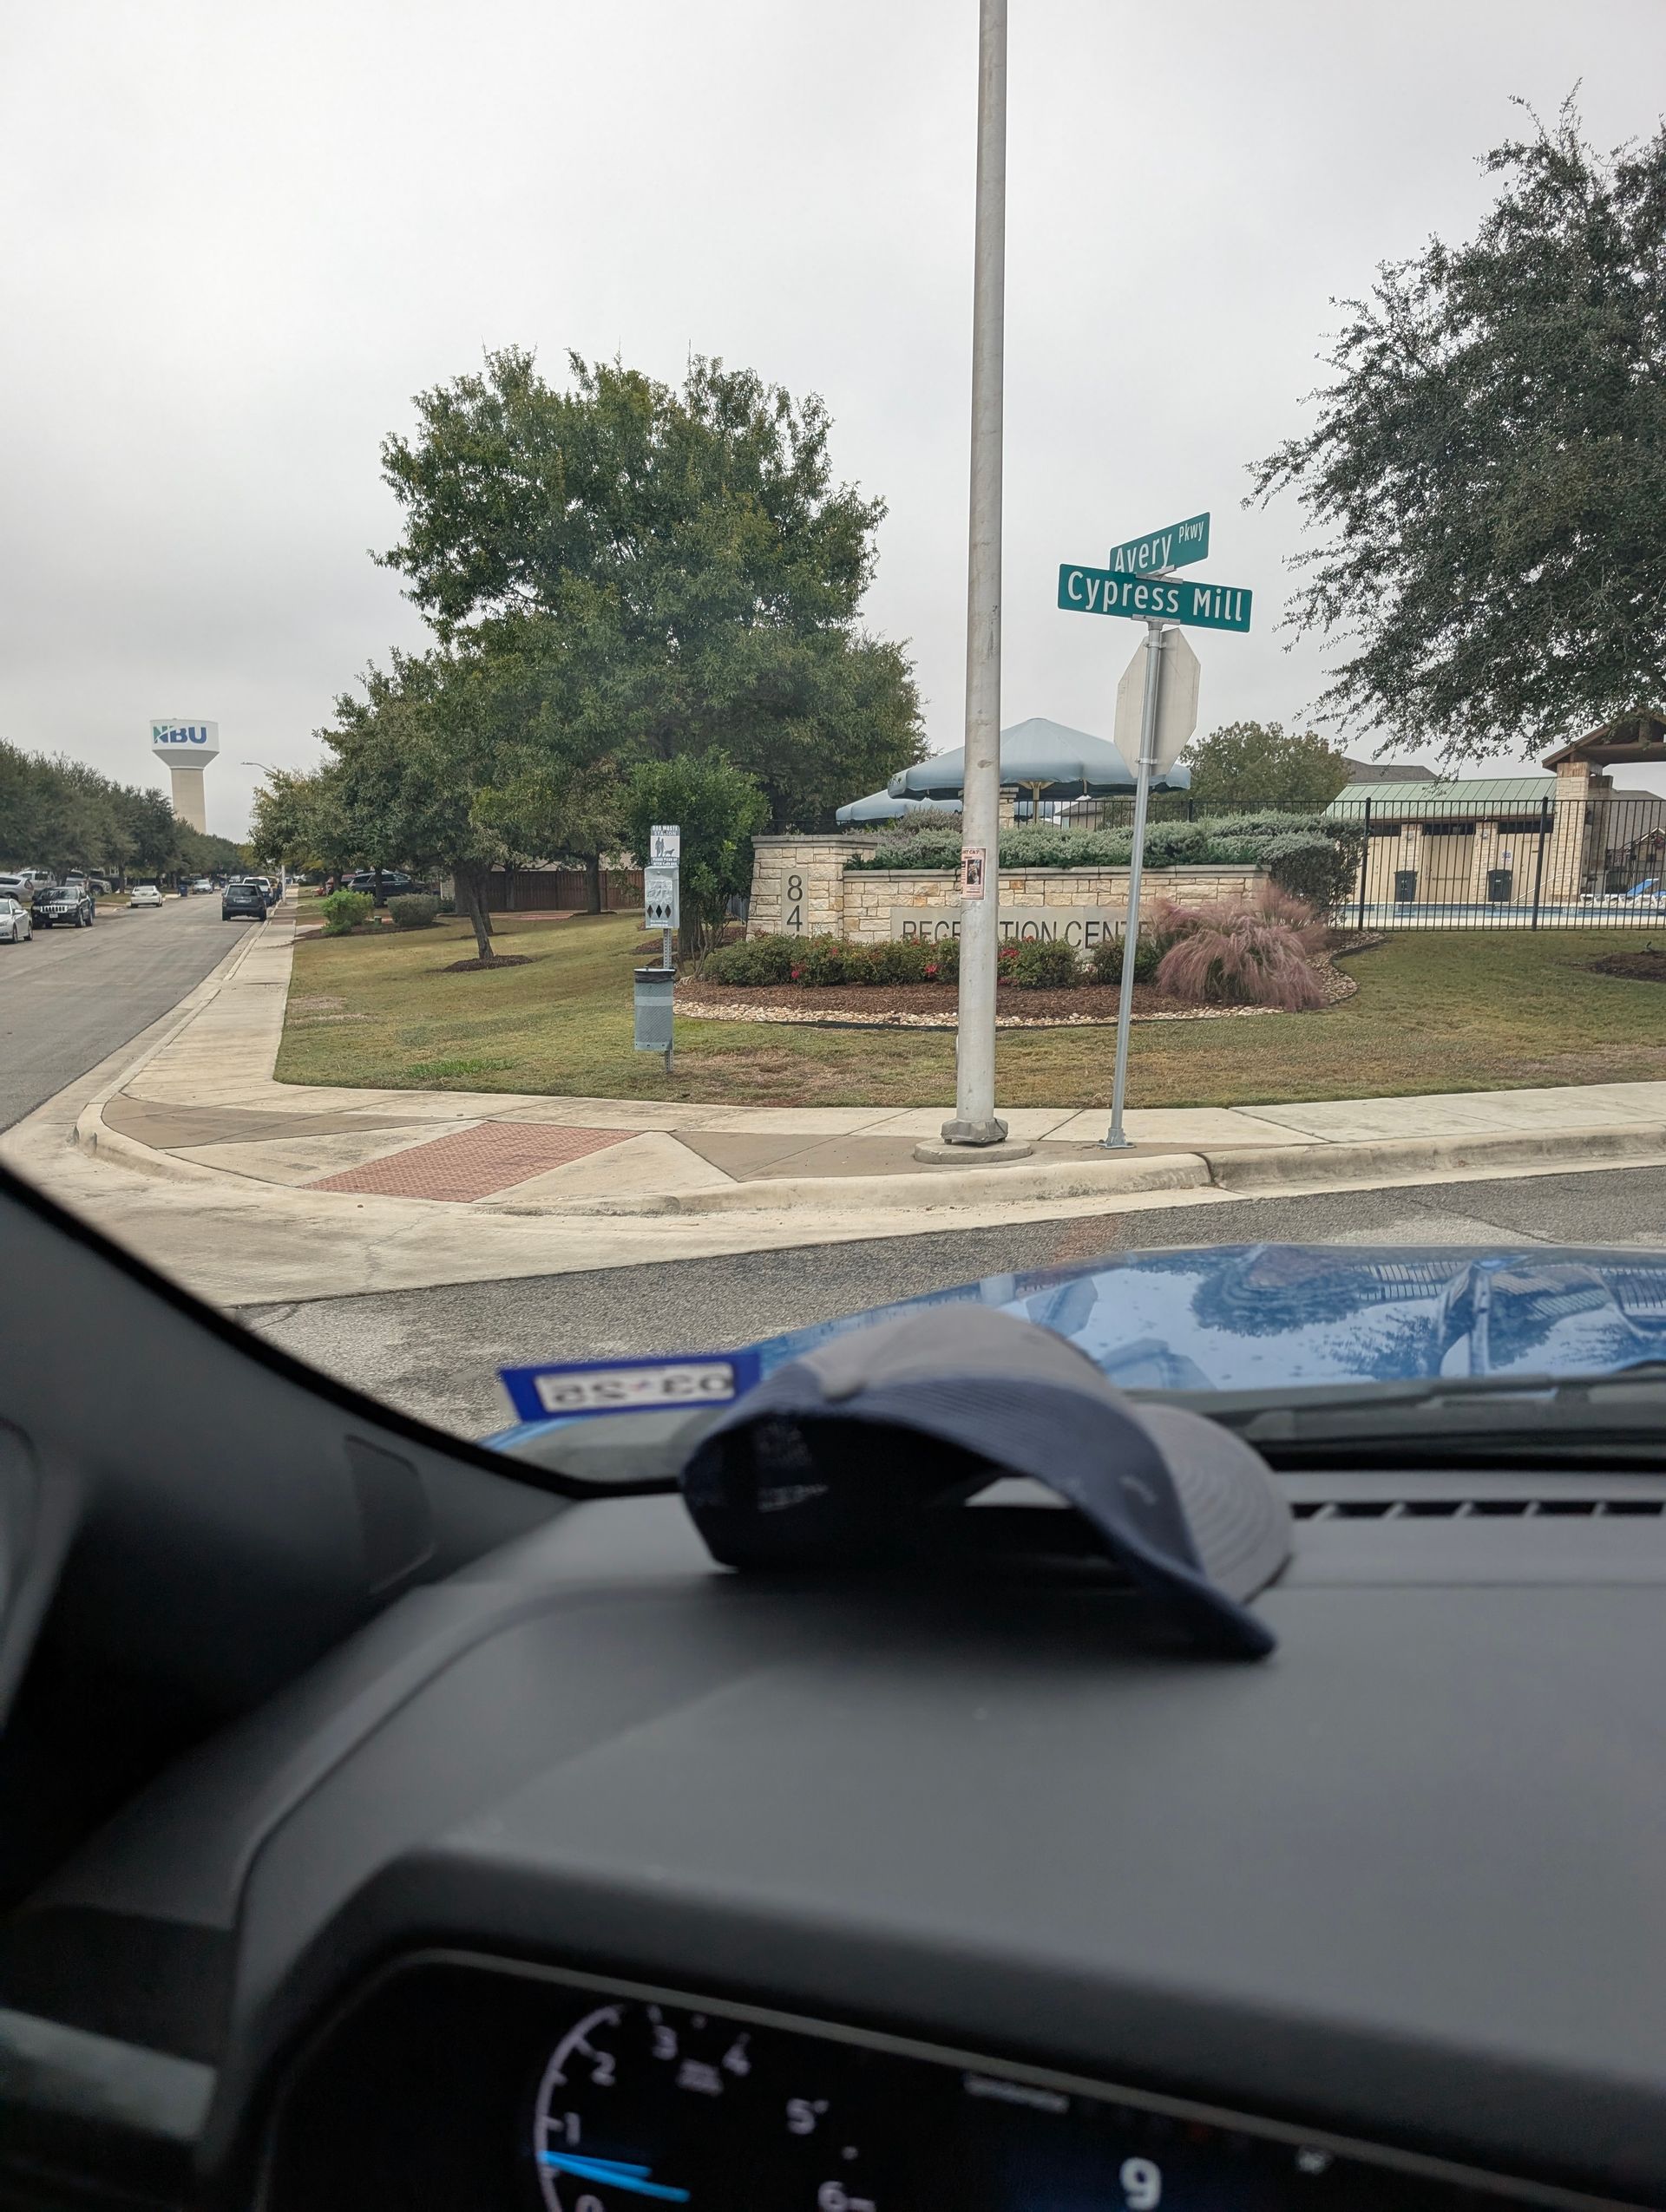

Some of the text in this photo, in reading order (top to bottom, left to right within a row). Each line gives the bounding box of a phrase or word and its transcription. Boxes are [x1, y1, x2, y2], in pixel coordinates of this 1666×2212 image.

[1114, 520, 1204, 573] Avery Pkwy
[1067, 571, 1243, 622] Cypress Mill
[153, 725, 207, 744] NBU
[902, 920, 1057, 943] RECTION
[651, 2025, 678, 2060] 3
[722, 2043, 751, 2077] 4
[591, 2051, 616, 2086] 2
[564, 2111, 580, 2146] 1
[786, 2097, 816, 2135] 5
[1119, 2156, 1162, 2210] 9
